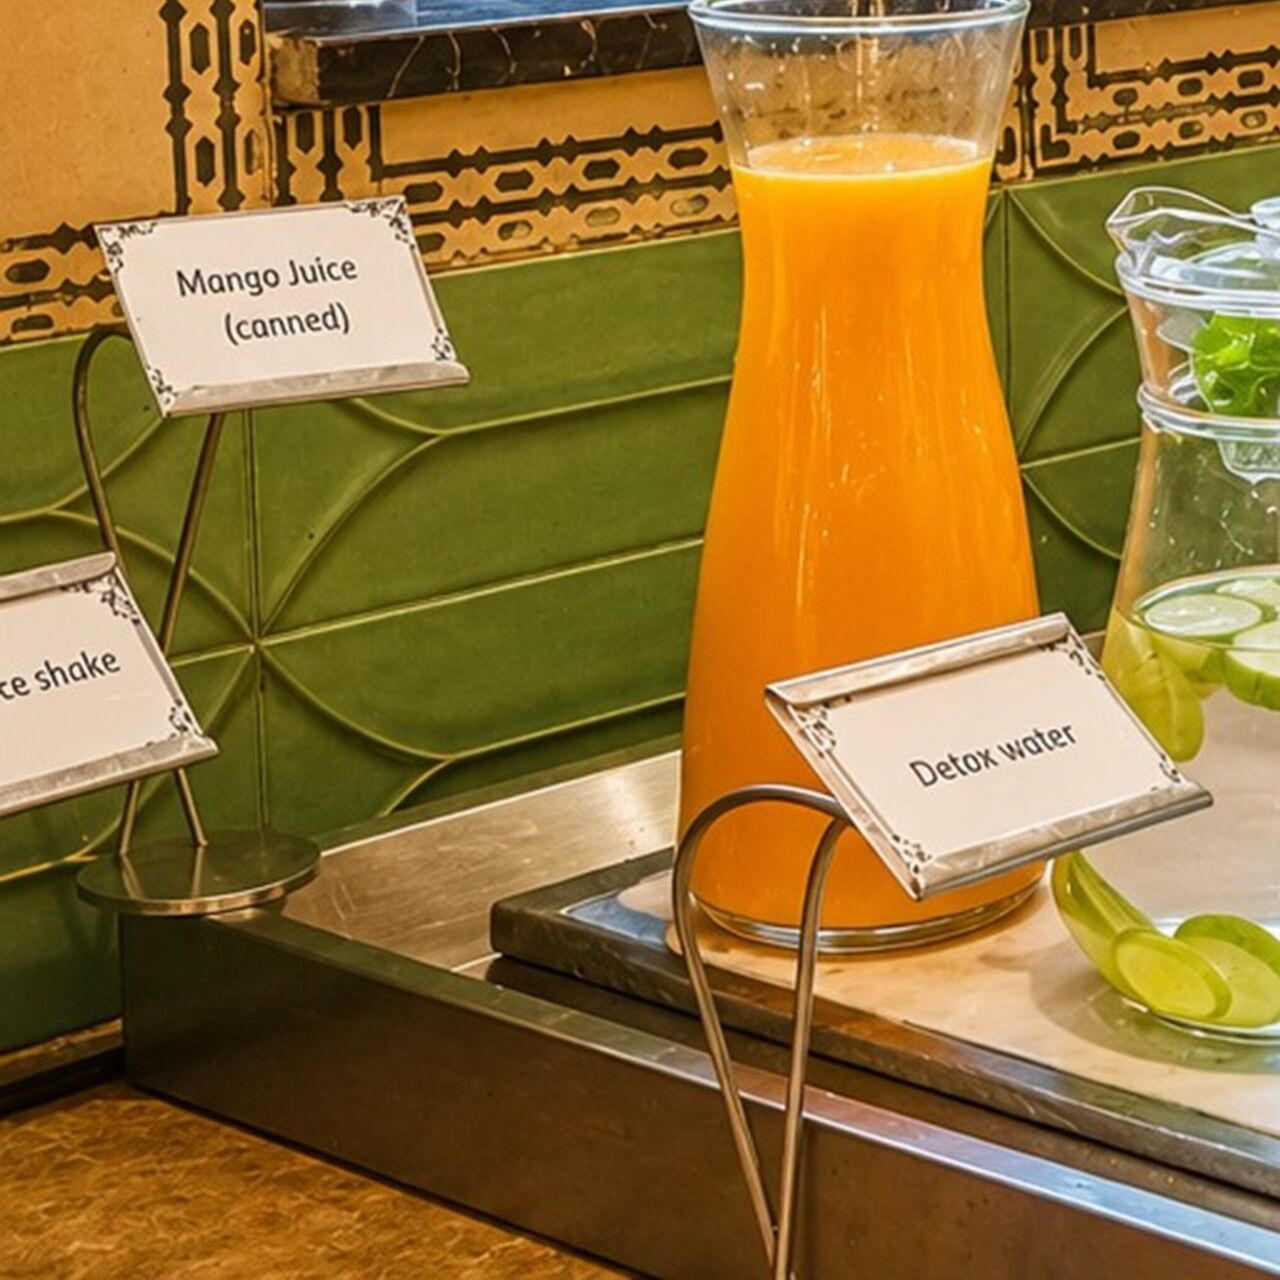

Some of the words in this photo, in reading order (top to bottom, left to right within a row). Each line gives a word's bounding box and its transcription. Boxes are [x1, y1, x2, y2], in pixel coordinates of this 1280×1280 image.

[176, 268, 280, 297] Mango
[289, 256, 357, 286] Juice
[225, 302, 350, 346] (canned)
[34, 651, 121, 691] shake
[909, 748, 998, 787] Detox
[997, 724, 1076, 761] water
